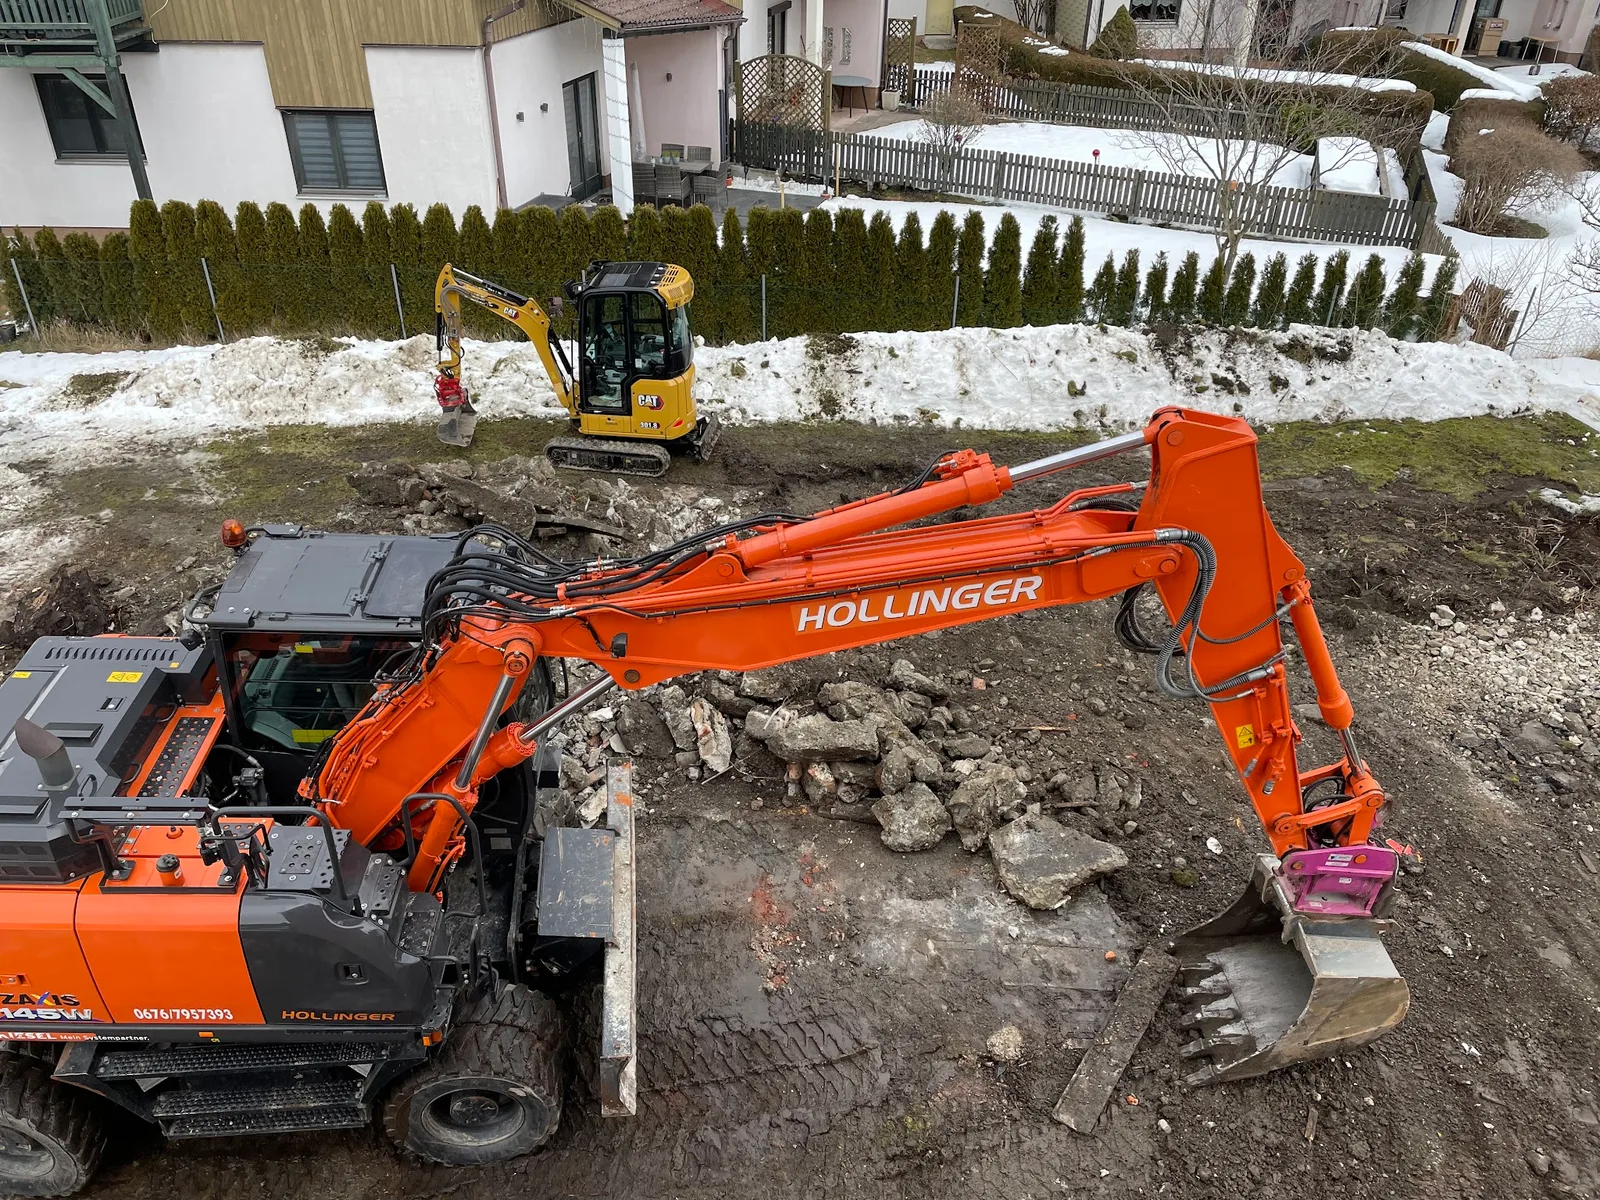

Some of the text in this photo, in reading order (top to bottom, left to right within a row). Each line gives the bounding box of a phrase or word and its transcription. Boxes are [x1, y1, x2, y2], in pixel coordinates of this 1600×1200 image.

[503, 307, 517, 317] CAT
[638, 395, 658, 407] CAT
[797, 575, 1043, 632] HOLLINGER
[0, 991, 80, 1006] ZAXIS
[133, 1008, 234, 1020] 0676/7957393
[281, 1010, 396, 1021] HOLLINGER
